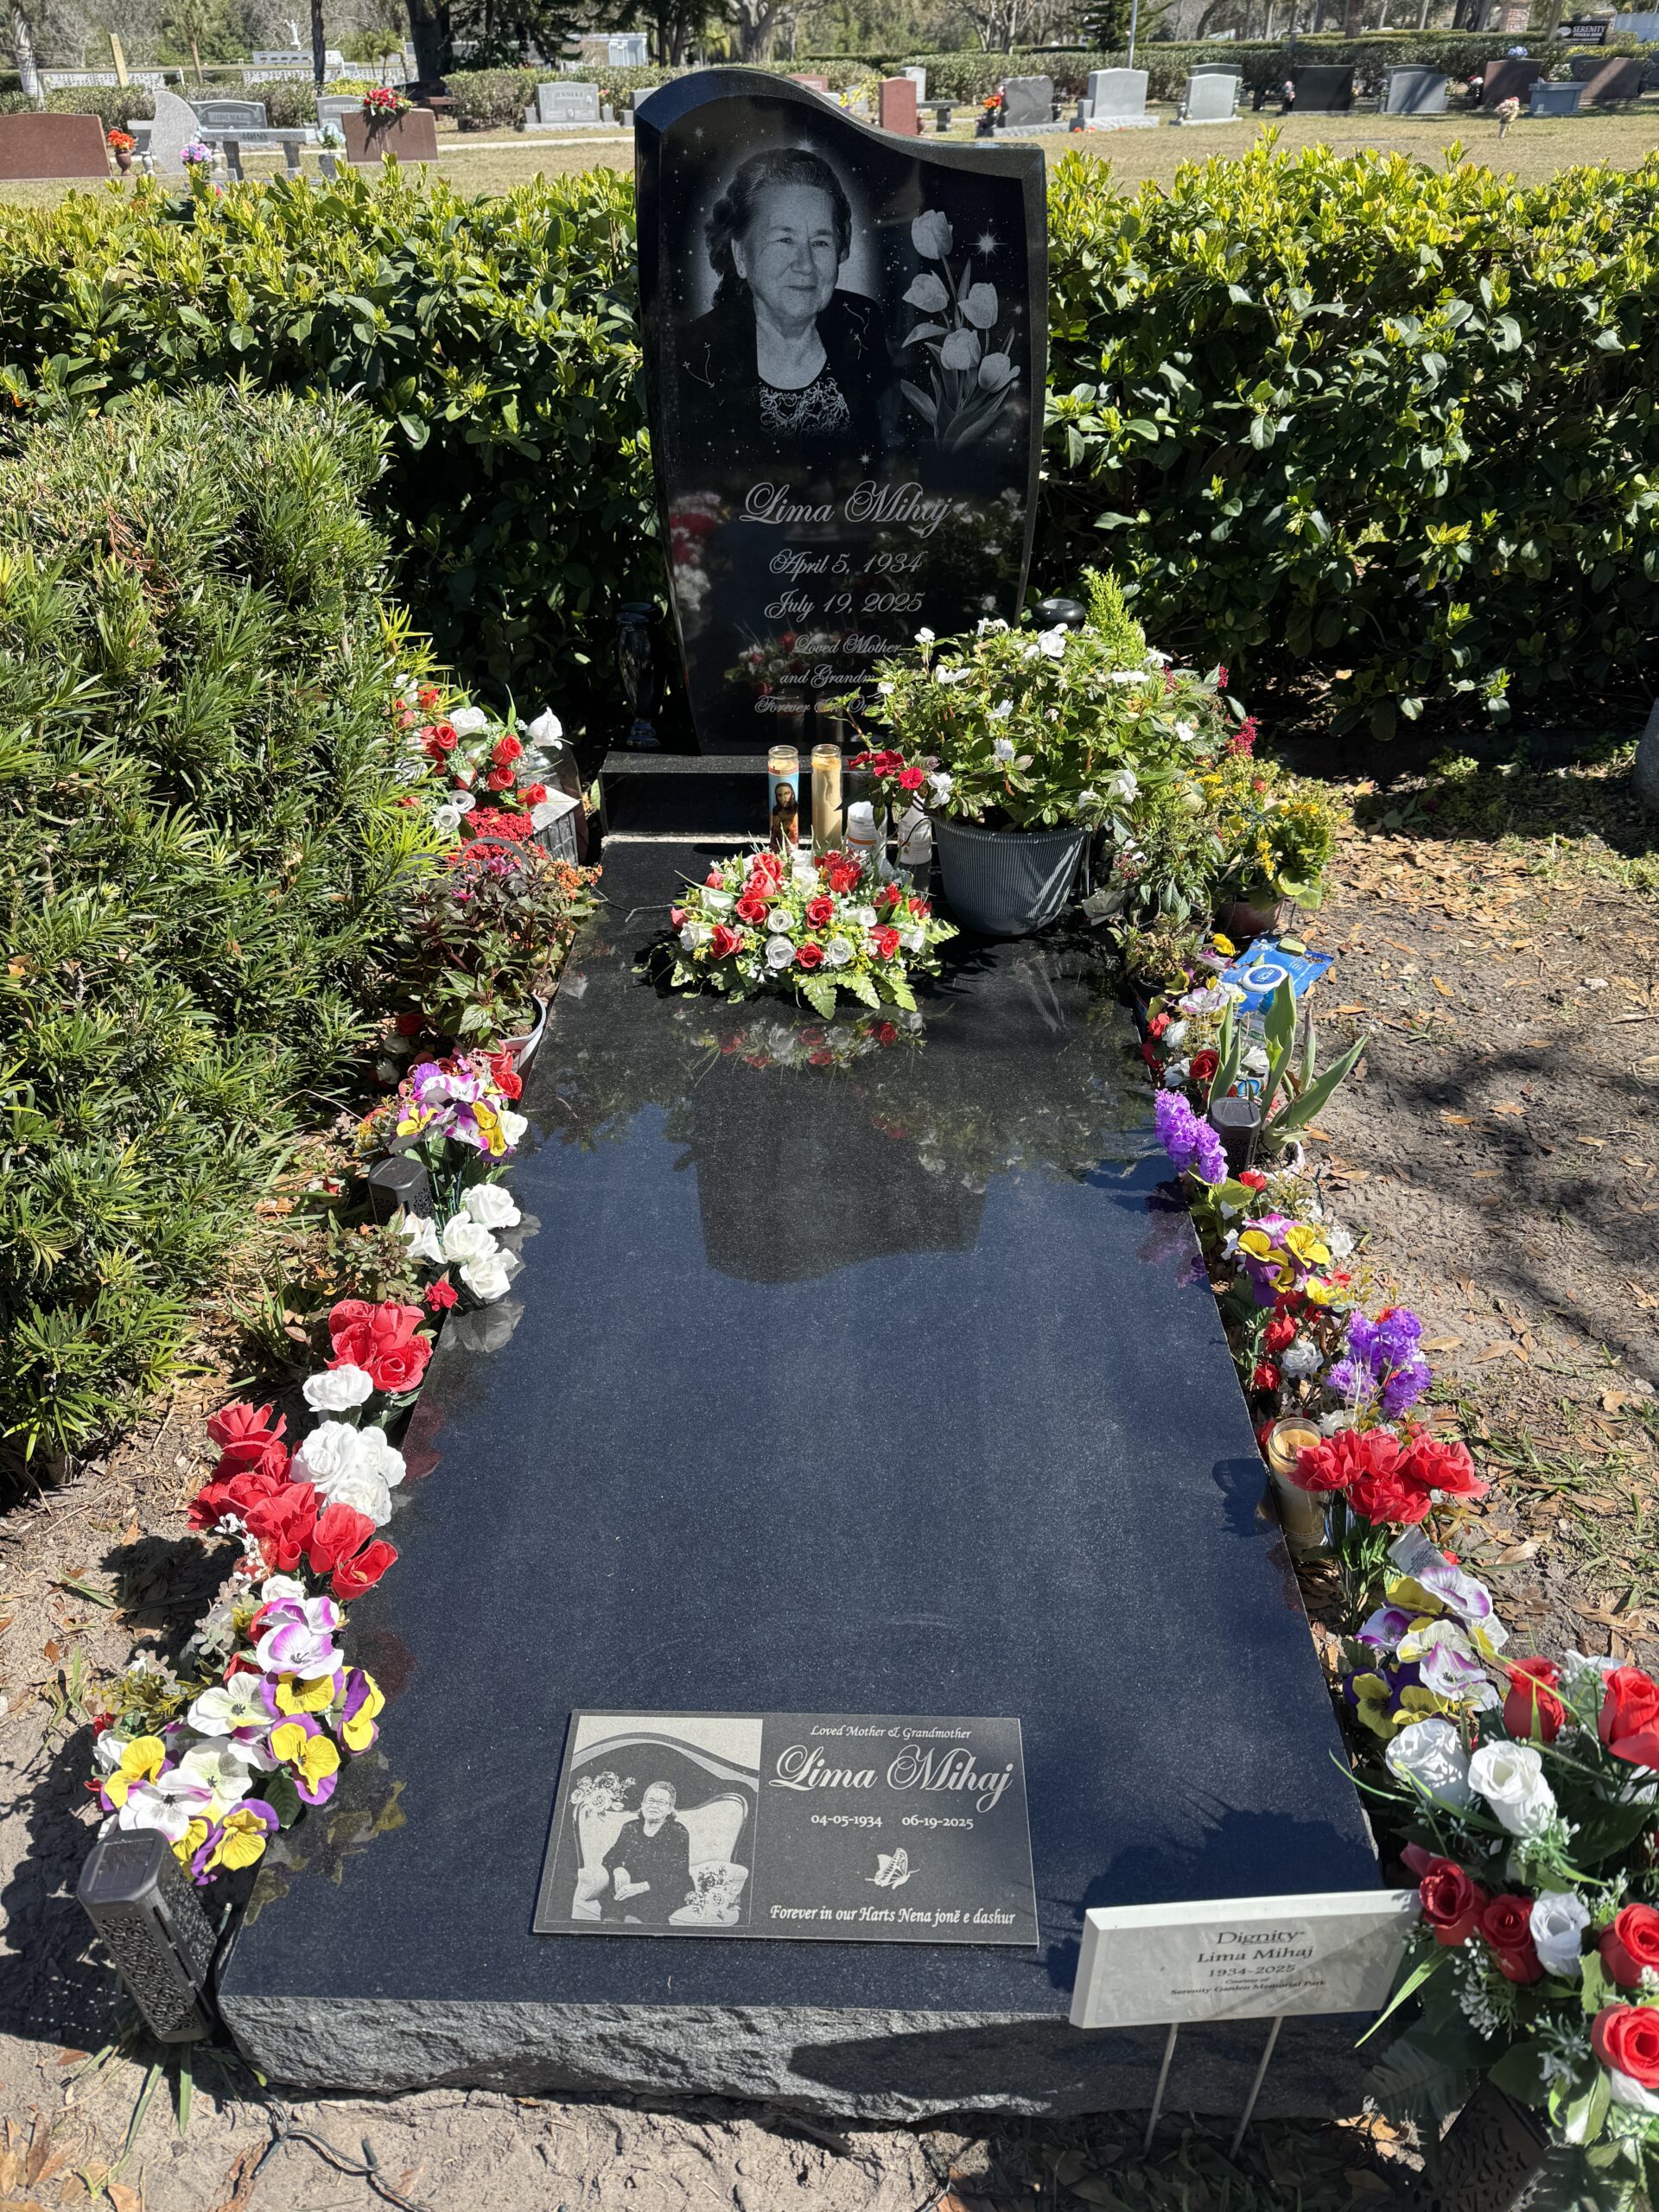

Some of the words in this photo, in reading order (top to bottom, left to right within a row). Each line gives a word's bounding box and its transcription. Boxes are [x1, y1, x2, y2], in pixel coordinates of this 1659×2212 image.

[739, 481, 835, 524] Lima
[844, 480, 953, 538] Mihaj
[769, 549, 828, 582] April
[832, 552, 851, 576] 5,
[863, 550, 929, 575] 1934
[764, 588, 815, 622] July
[823, 592, 854, 615] 19,
[862, 592, 925, 613] 2025
[792, 634, 841, 655] Loved
[842, 633, 901, 655] Mother
[779, 669, 811, 684] and
[810, 664, 875, 689] Grandm
[754, 696, 810, 714] Forever
[810, 1725, 844, 1736] Loved
[845, 1725, 887, 1737] Mother
[887, 1726, 900, 1738] &
[901, 1726, 972, 1740] Grandmother
[768, 1744, 879, 1792] Lima
[886, 1744, 1014, 1813] Mihaj
[810, 1814, 883, 1828] 04-05-1934
[902, 1815, 974, 1830] 06-19-2025
[770, 1904, 818, 1920] Forever
[820, 1906, 832, 1920] in
[836, 1910, 858, 1921] our
[858, 1906, 895, 1922] Harts
[897, 1908, 932, 1923] Nena
[931, 1910, 961, 1927] jonë
[963, 1913, 970, 1923] e
[973, 1908, 1016, 1925] dashur
[1217, 1929, 1300, 1945] Dignity
[1197, 1951, 1247, 1963] Lima
[1252, 1946, 1314, 1960] Mihaj
[1209, 1964, 1296, 1978] 1934-2025
[1170, 1987, 1211, 1996] Serenity
[1252, 1981, 1301, 1990] Memorial
